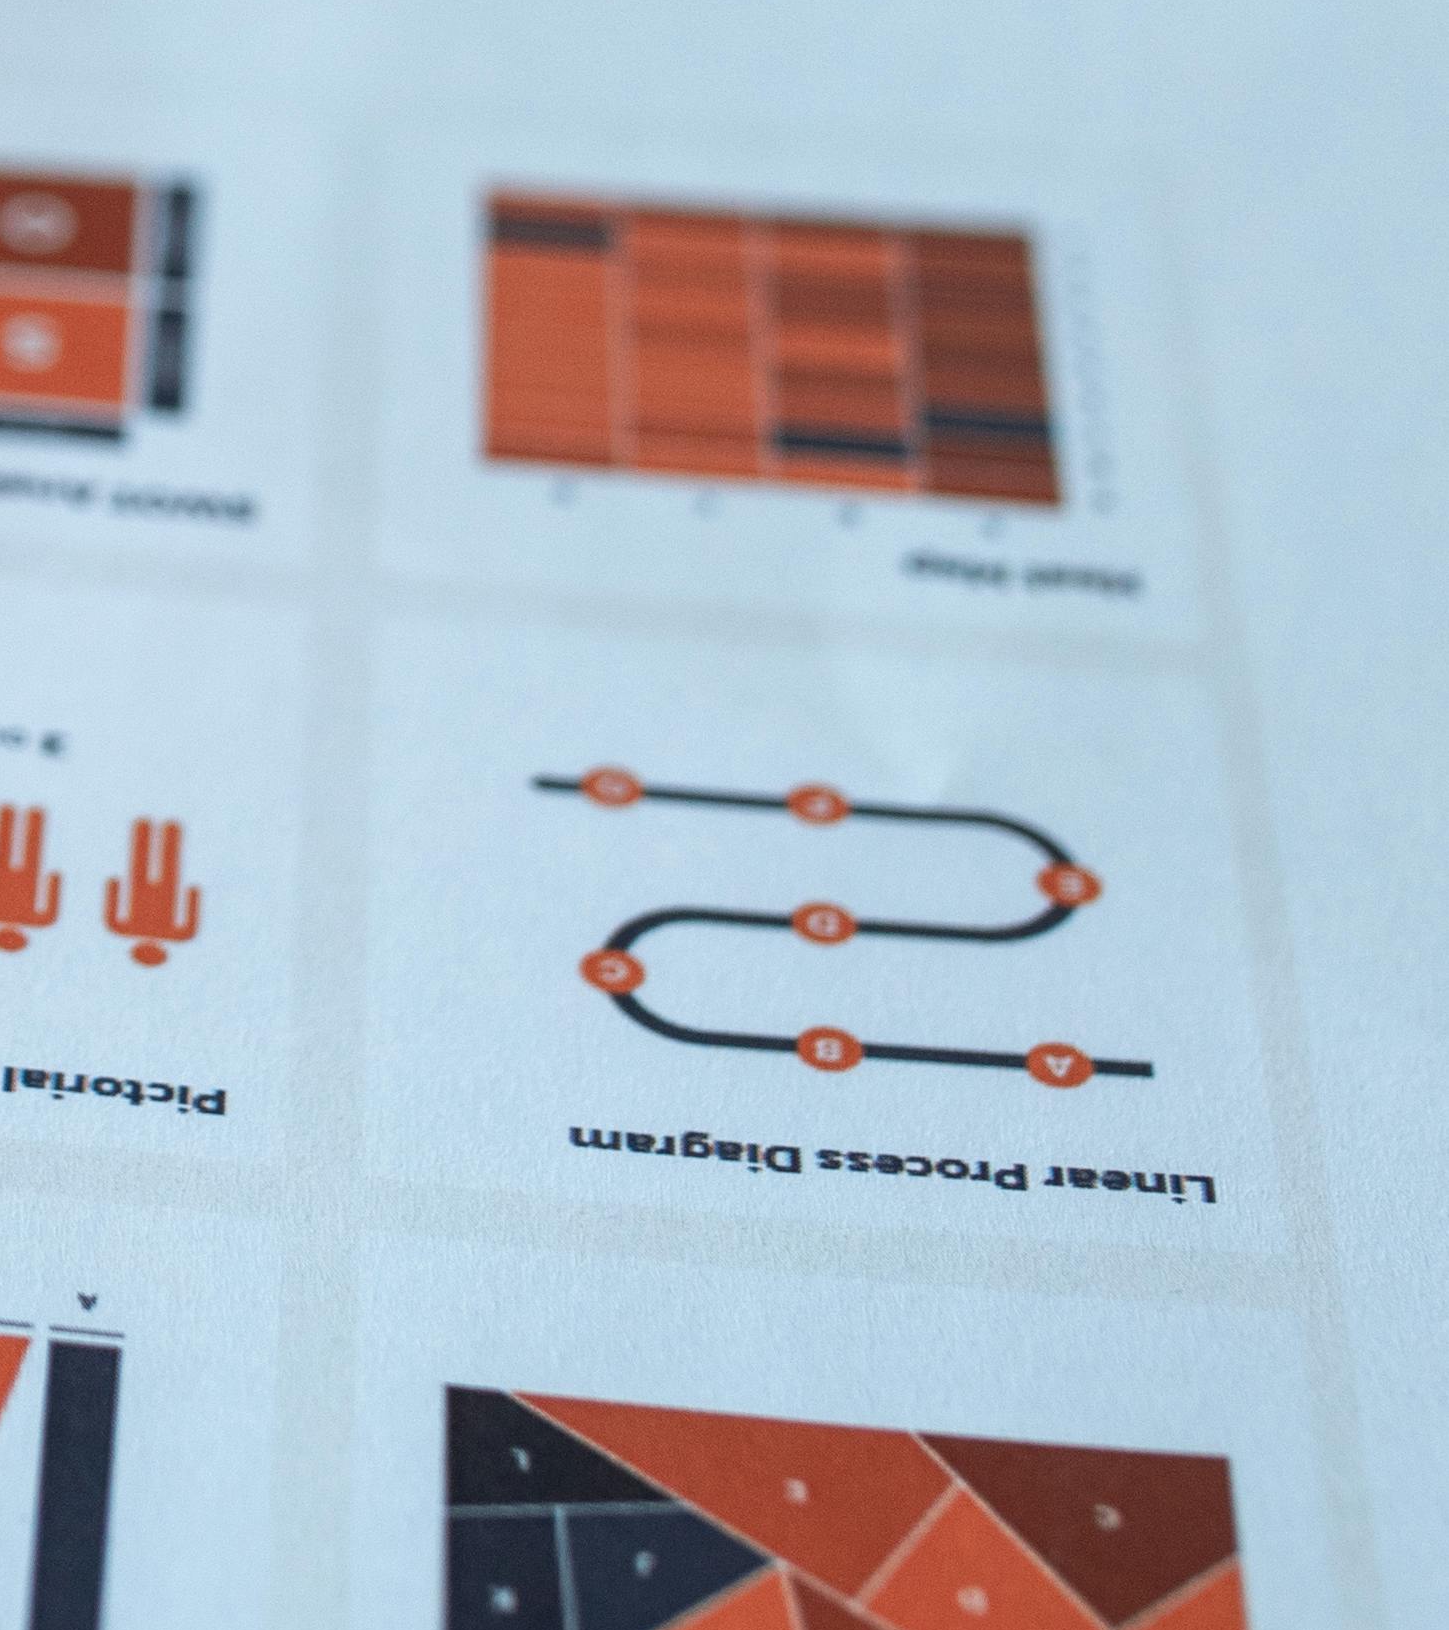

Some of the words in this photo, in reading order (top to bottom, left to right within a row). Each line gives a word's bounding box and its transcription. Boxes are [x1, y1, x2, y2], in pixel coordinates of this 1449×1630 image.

[3, 1067, 226, 1115] Pictorial
[570, 1127, 801, 1174] Diagram
[817, 1150, 1027, 1191] Process
[1044, 1167, 1216, 1204] Linear
